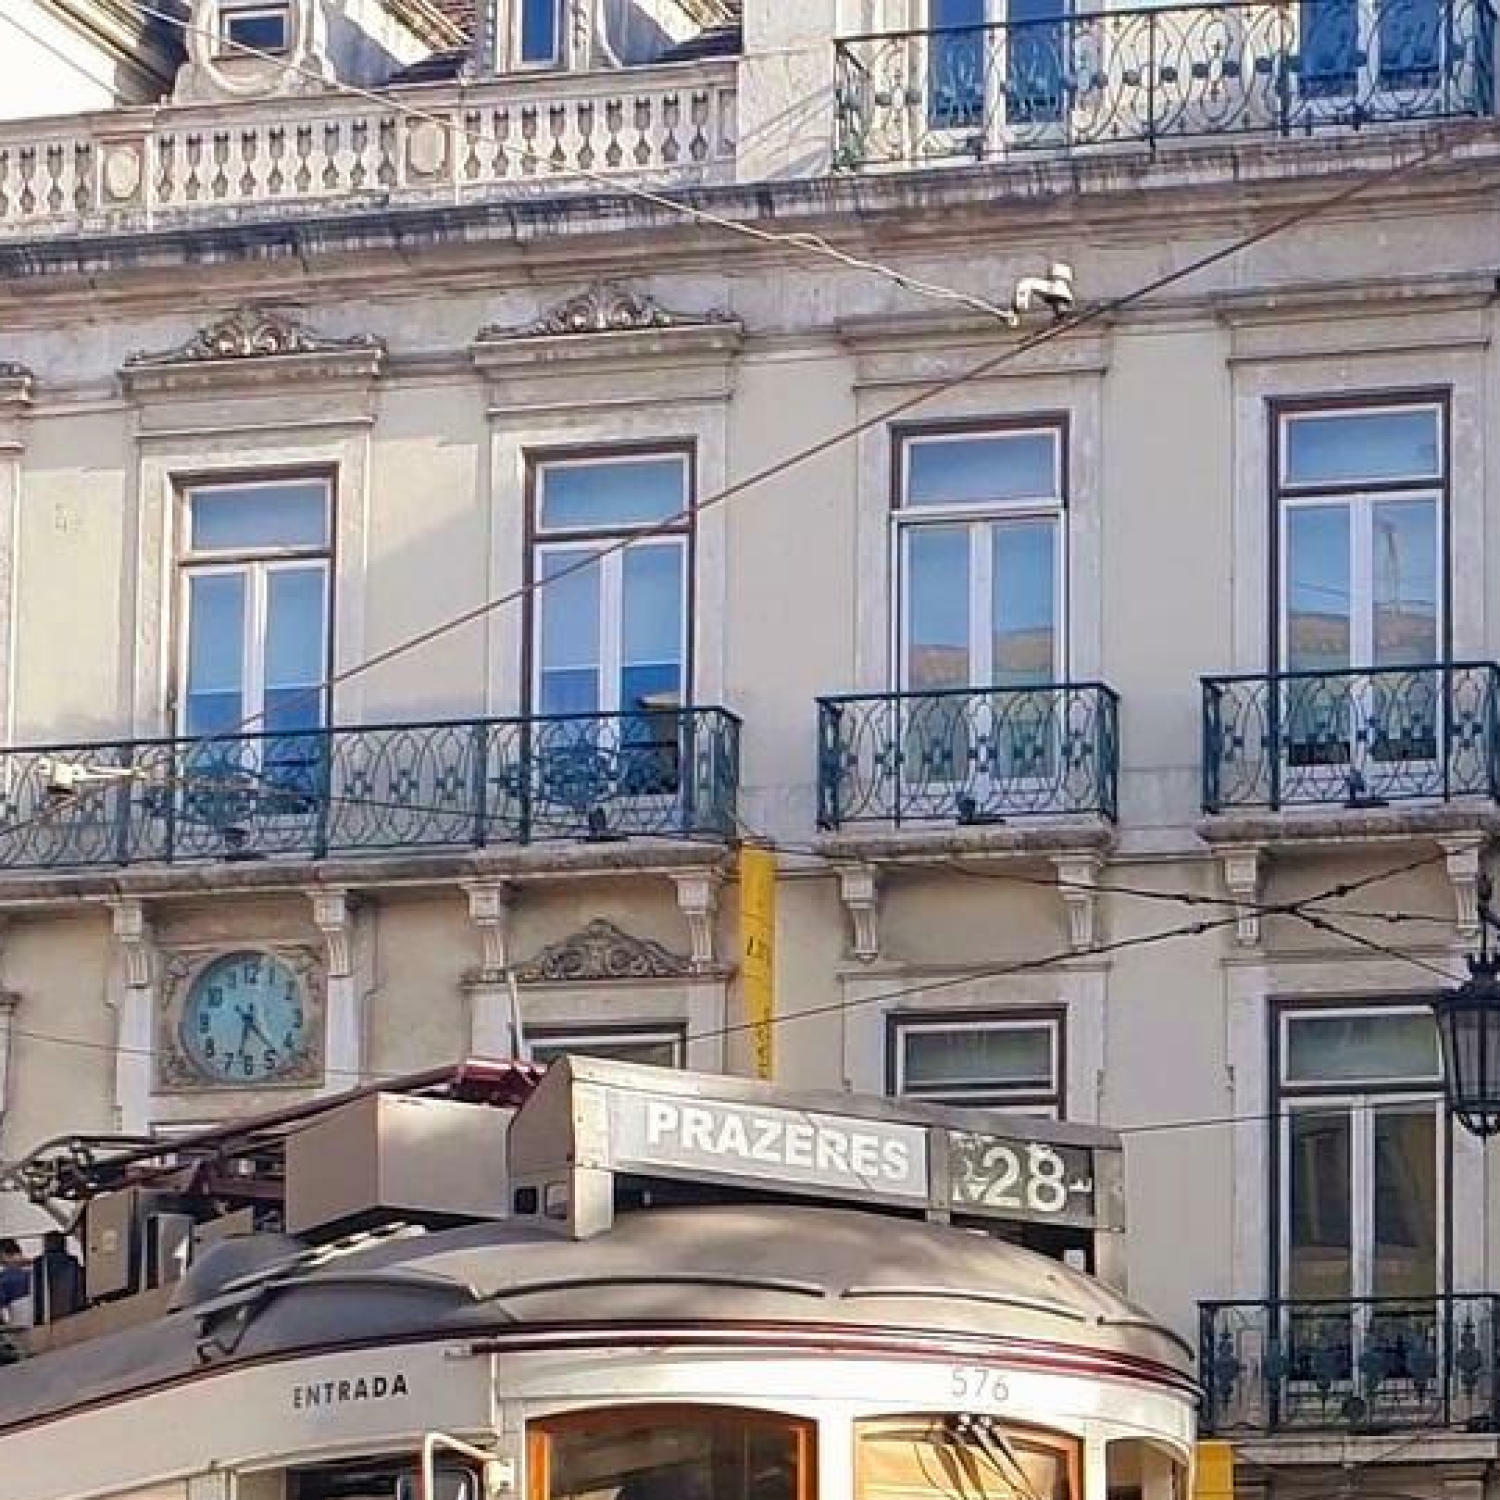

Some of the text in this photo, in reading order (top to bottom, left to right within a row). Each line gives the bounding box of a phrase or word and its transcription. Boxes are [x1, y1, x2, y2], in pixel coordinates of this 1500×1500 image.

[648, 1102, 910, 1180] PRAZERES
[293, 1374, 409, 1409] ENTRADA
[952, 1367, 1009, 1402] 576
